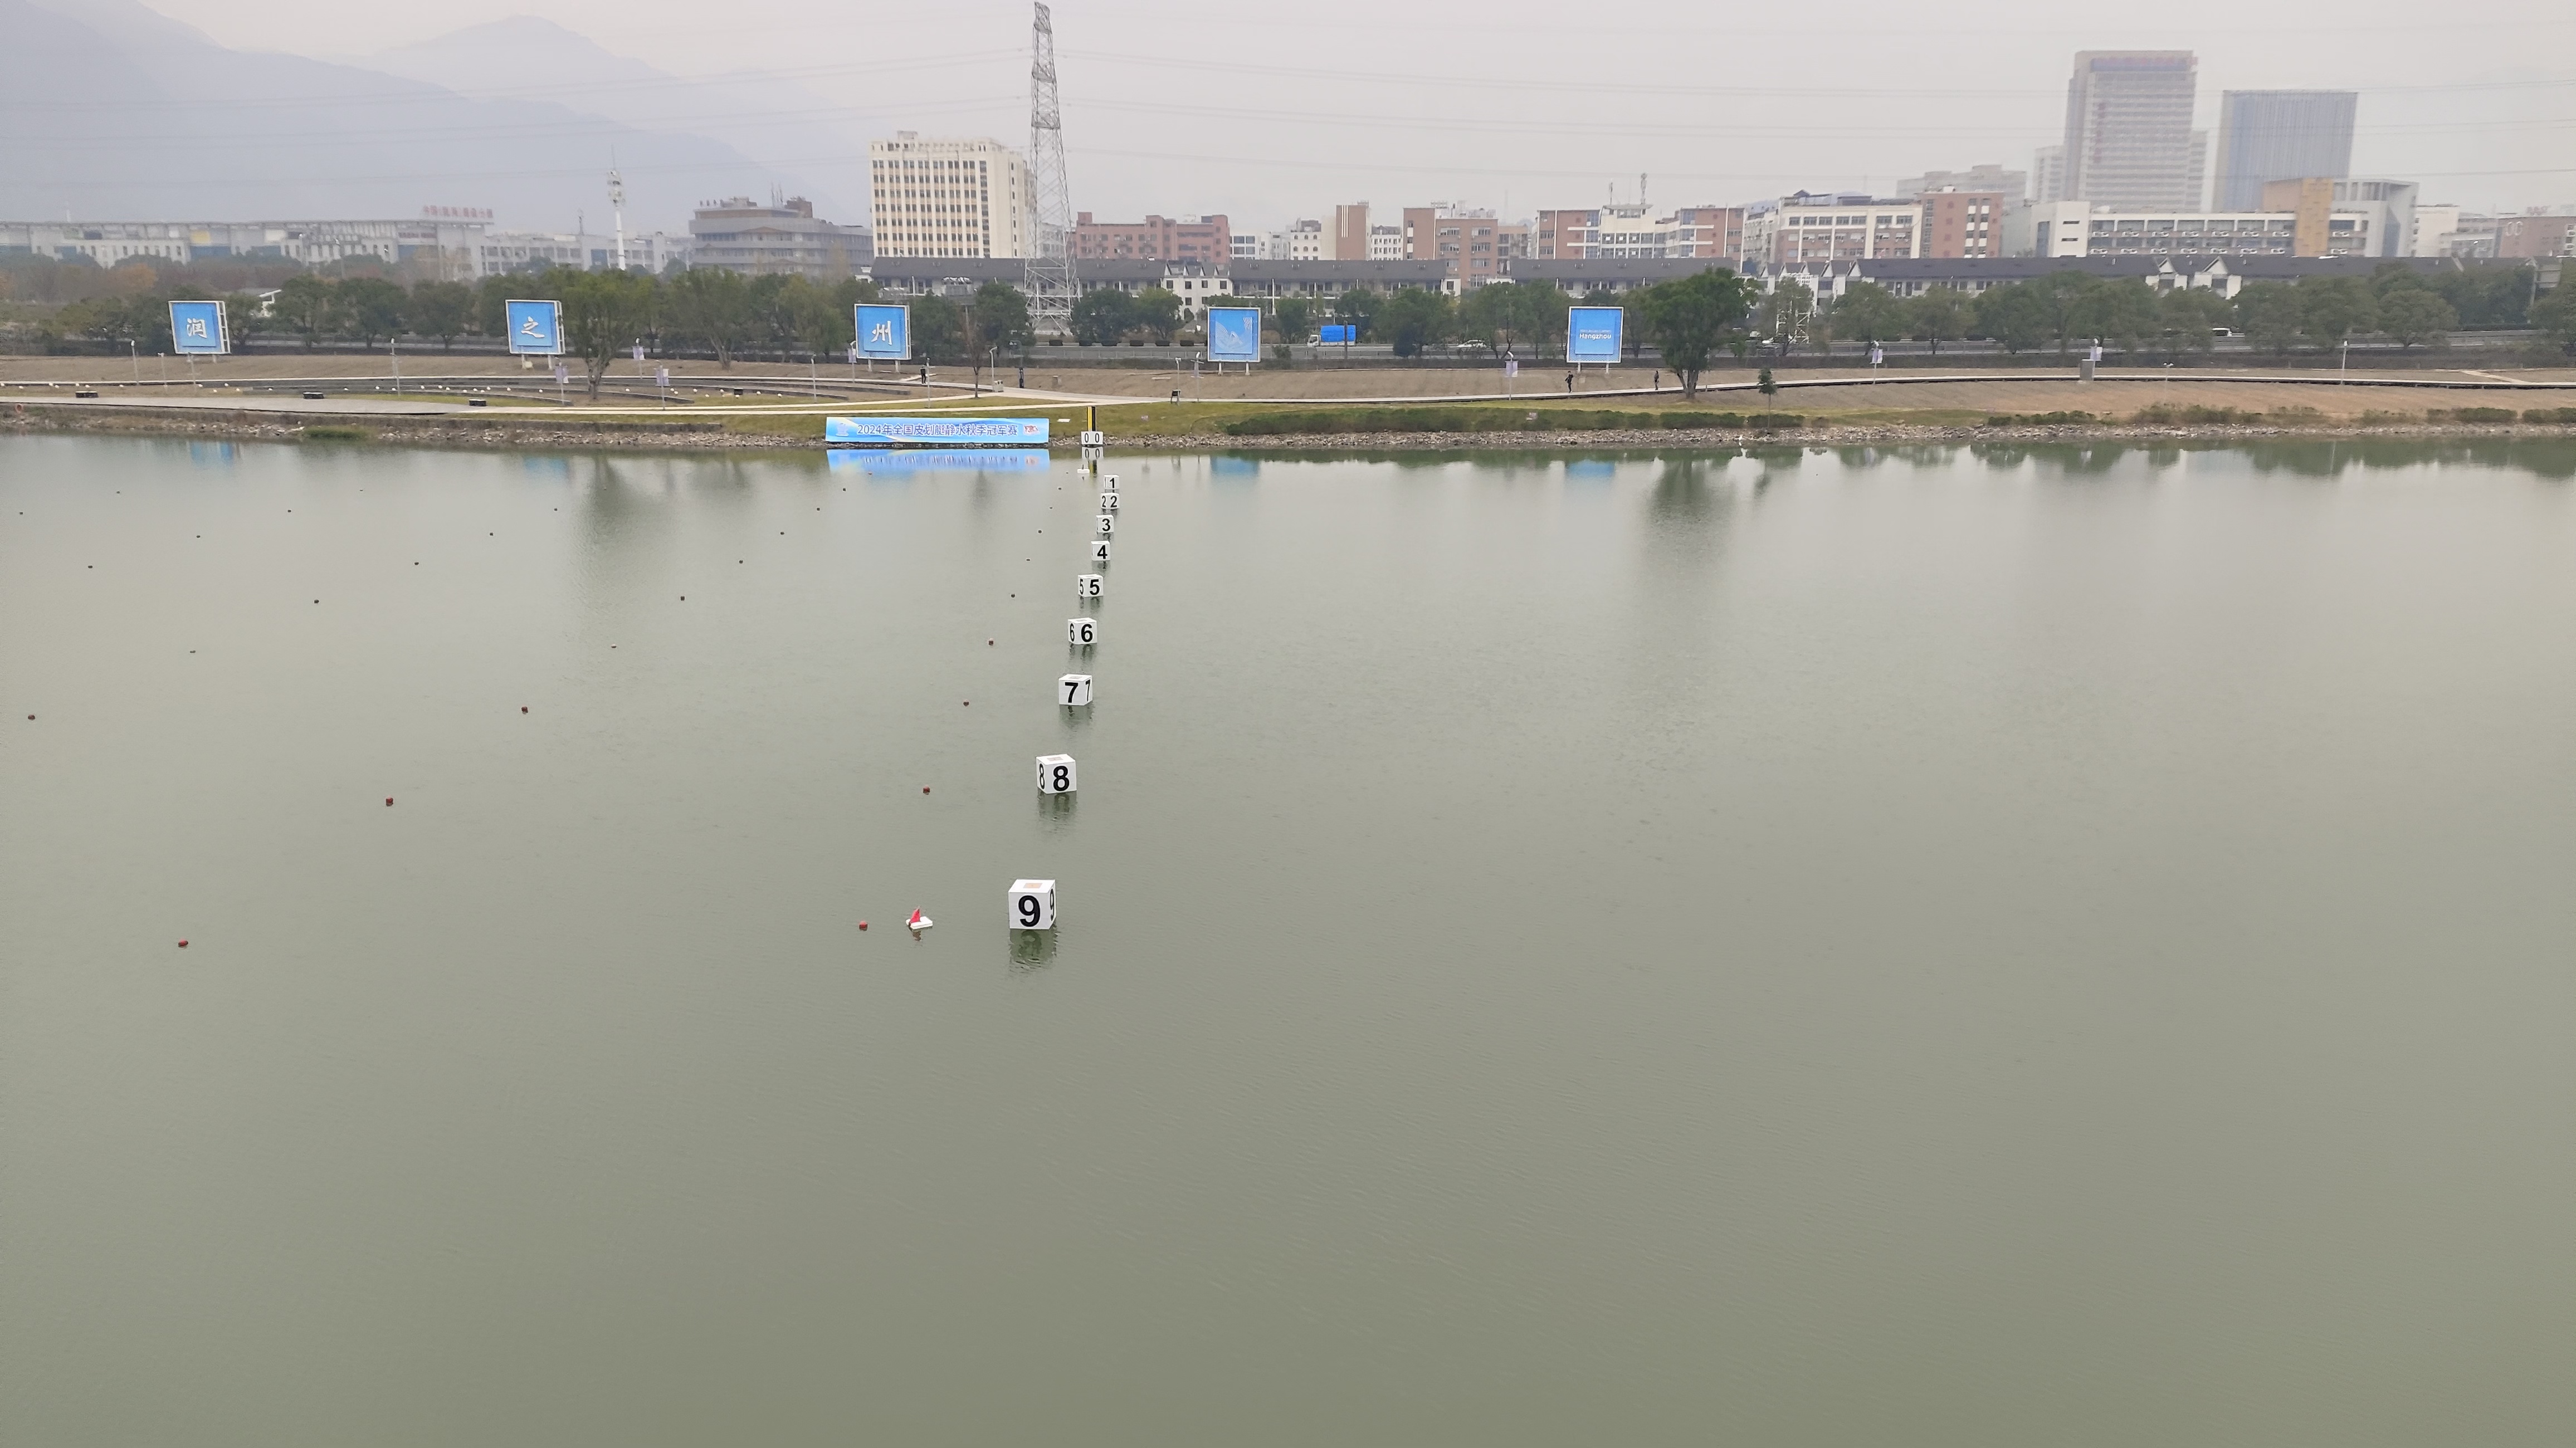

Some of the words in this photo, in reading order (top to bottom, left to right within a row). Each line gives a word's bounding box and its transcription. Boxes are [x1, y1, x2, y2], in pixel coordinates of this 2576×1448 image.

[186, 317, 207, 339] 润
[521, 316, 545, 338] 之
[871, 320, 892, 345] 州
[857, 423, 1018, 437] 2024年全国皮划艇静水秋季冠军赛
[1085, 433, 1089, 443] 0
[1095, 433, 1100, 443] 0
[1109, 477, 1115, 488] 1
[1101, 496, 1106, 507] 2
[1110, 496, 1118, 507] 2
[1102, 518, 1111, 531] 3
[1097, 545, 1108, 559] 4
[1079, 578, 1084, 595] 5
[1090, 579, 1100, 595] 5
[1070, 623, 1075, 642] 6
[1081, 623, 1093, 642] 6
[1065, 682, 1078, 703] 7
[1086, 679, 1091, 701] 7
[1039, 764, 1045, 789] 8
[1053, 765, 1070, 791] 8
[1018, 895, 1041, 927] 9
[1050, 888, 1055, 922] 9
